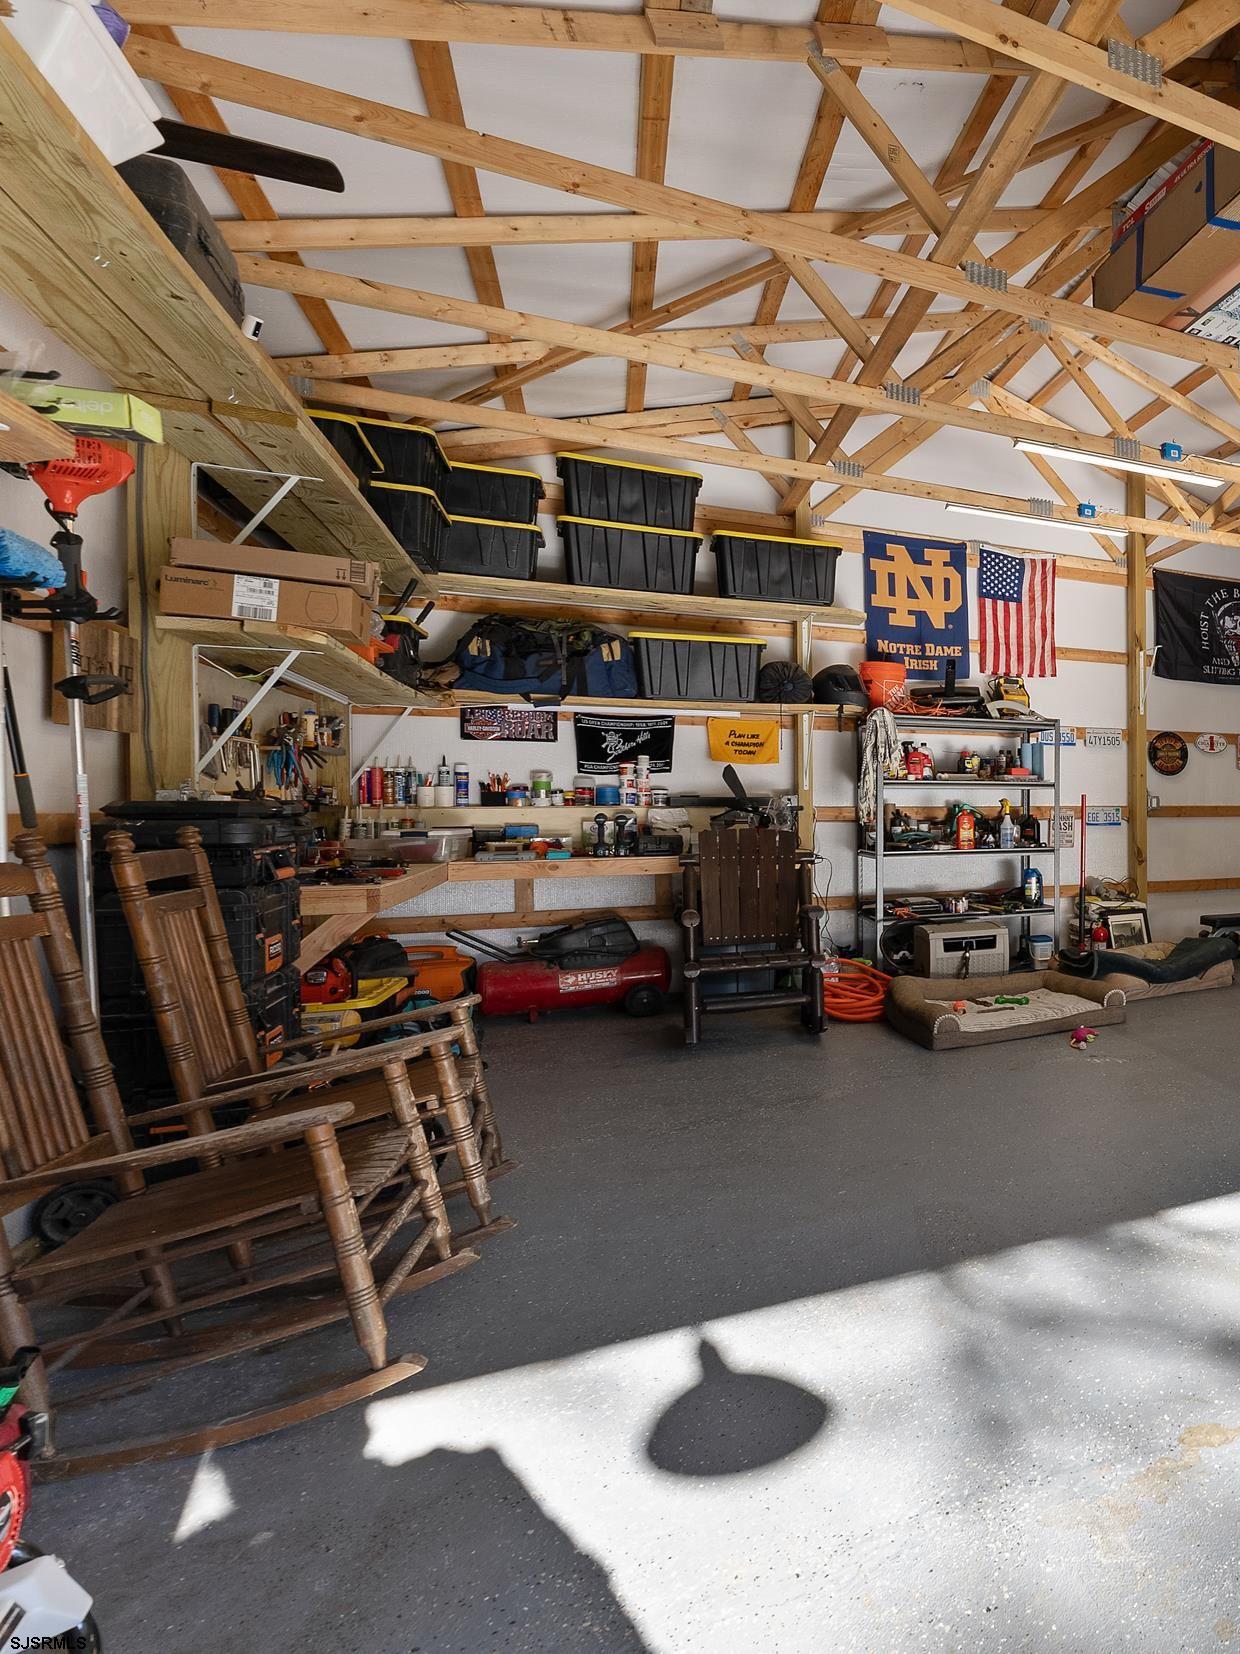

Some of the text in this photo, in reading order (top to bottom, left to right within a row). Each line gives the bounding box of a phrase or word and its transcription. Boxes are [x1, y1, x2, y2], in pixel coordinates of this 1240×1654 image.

[164, 574, 210, 587] Luminarc
[1205, 588, 1229, 609] THE
[1200, 612, 1210, 651] HOIST
[876, 639, 963, 657] NOTRE DAME
[904, 656, 938, 671] IRISH
[1212, 657, 1231, 667] AND
[500, 721, 555, 740] ROAR
[728, 730, 746, 739] PLAY
[1088, 736, 1121, 746] 4TY1505
[1087, 812, 1120, 823] EGE 3515
[577, 969, 619, 981] HUSKY
